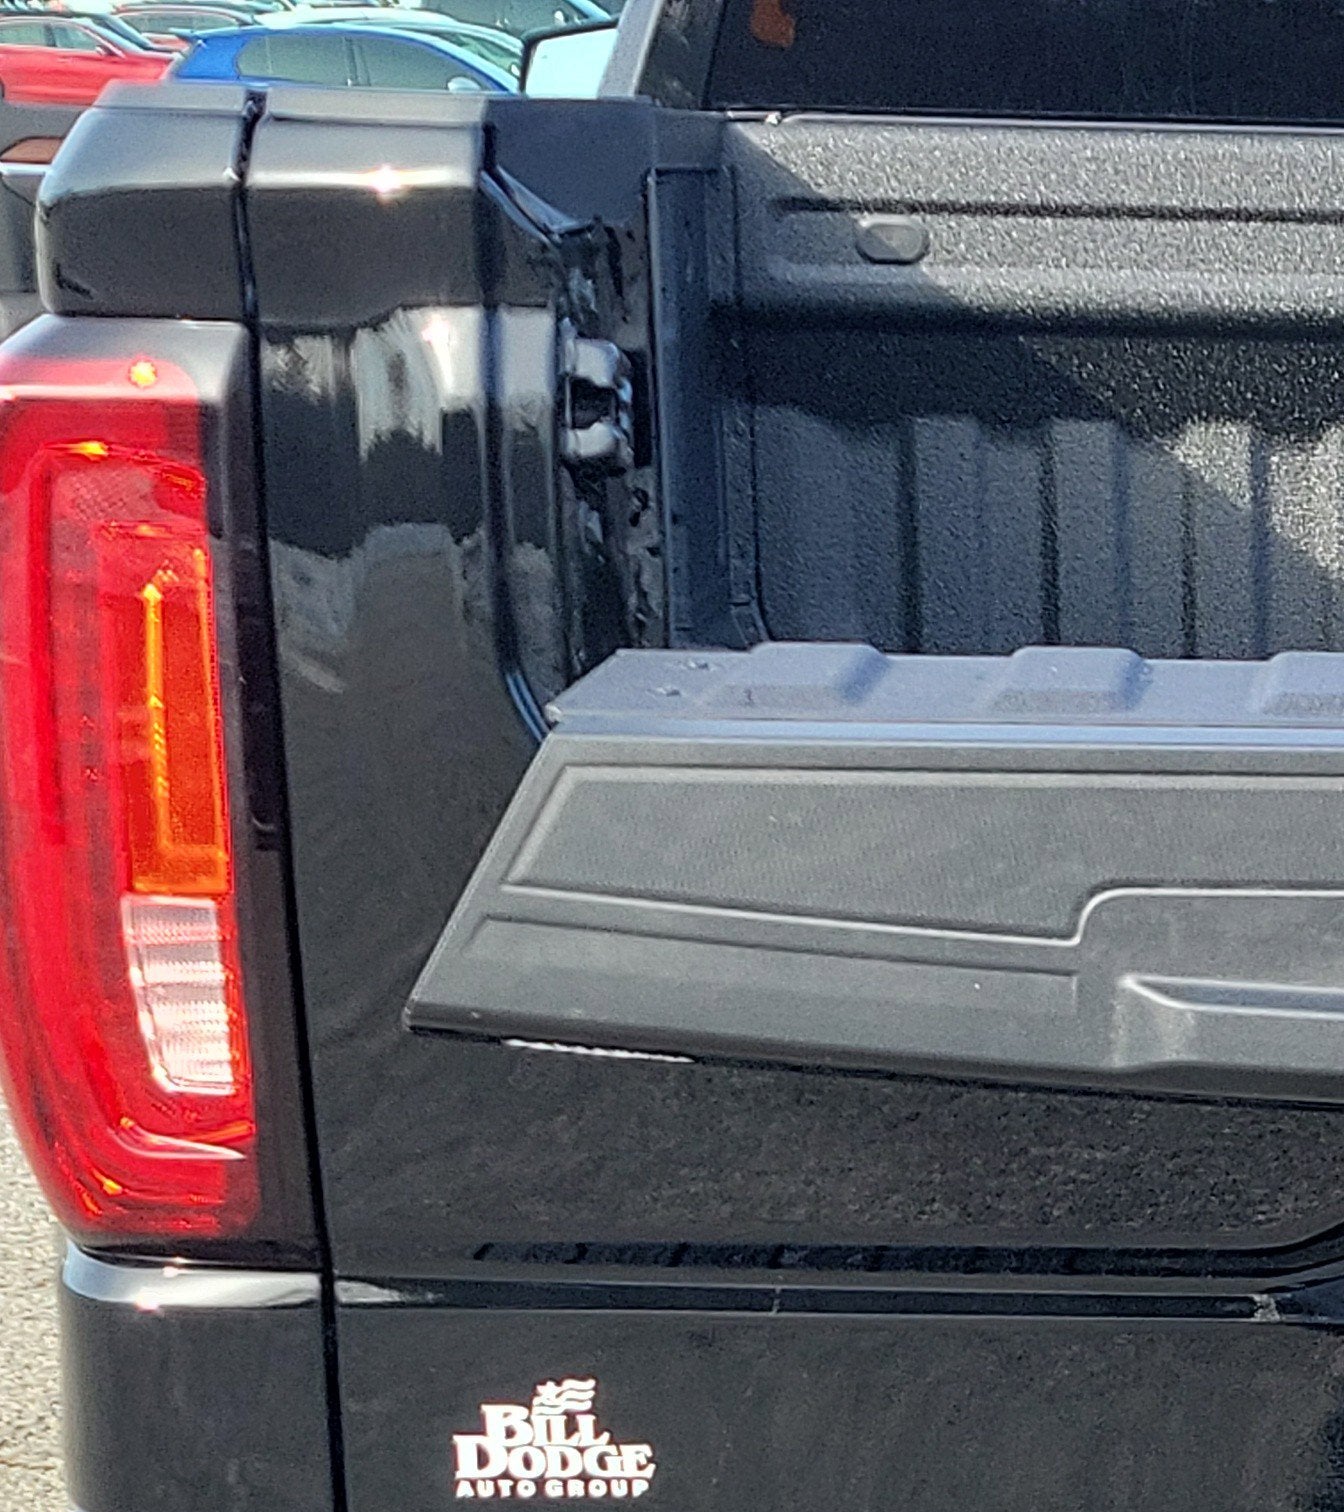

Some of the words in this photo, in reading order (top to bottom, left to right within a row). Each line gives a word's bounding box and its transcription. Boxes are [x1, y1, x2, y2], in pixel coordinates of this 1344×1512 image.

[480, 1403, 611, 1447] BILL
[452, 1434, 657, 1479] DODGE
[455, 1479, 537, 1498] AUTO
[544, 1479, 649, 1498] GROUP
